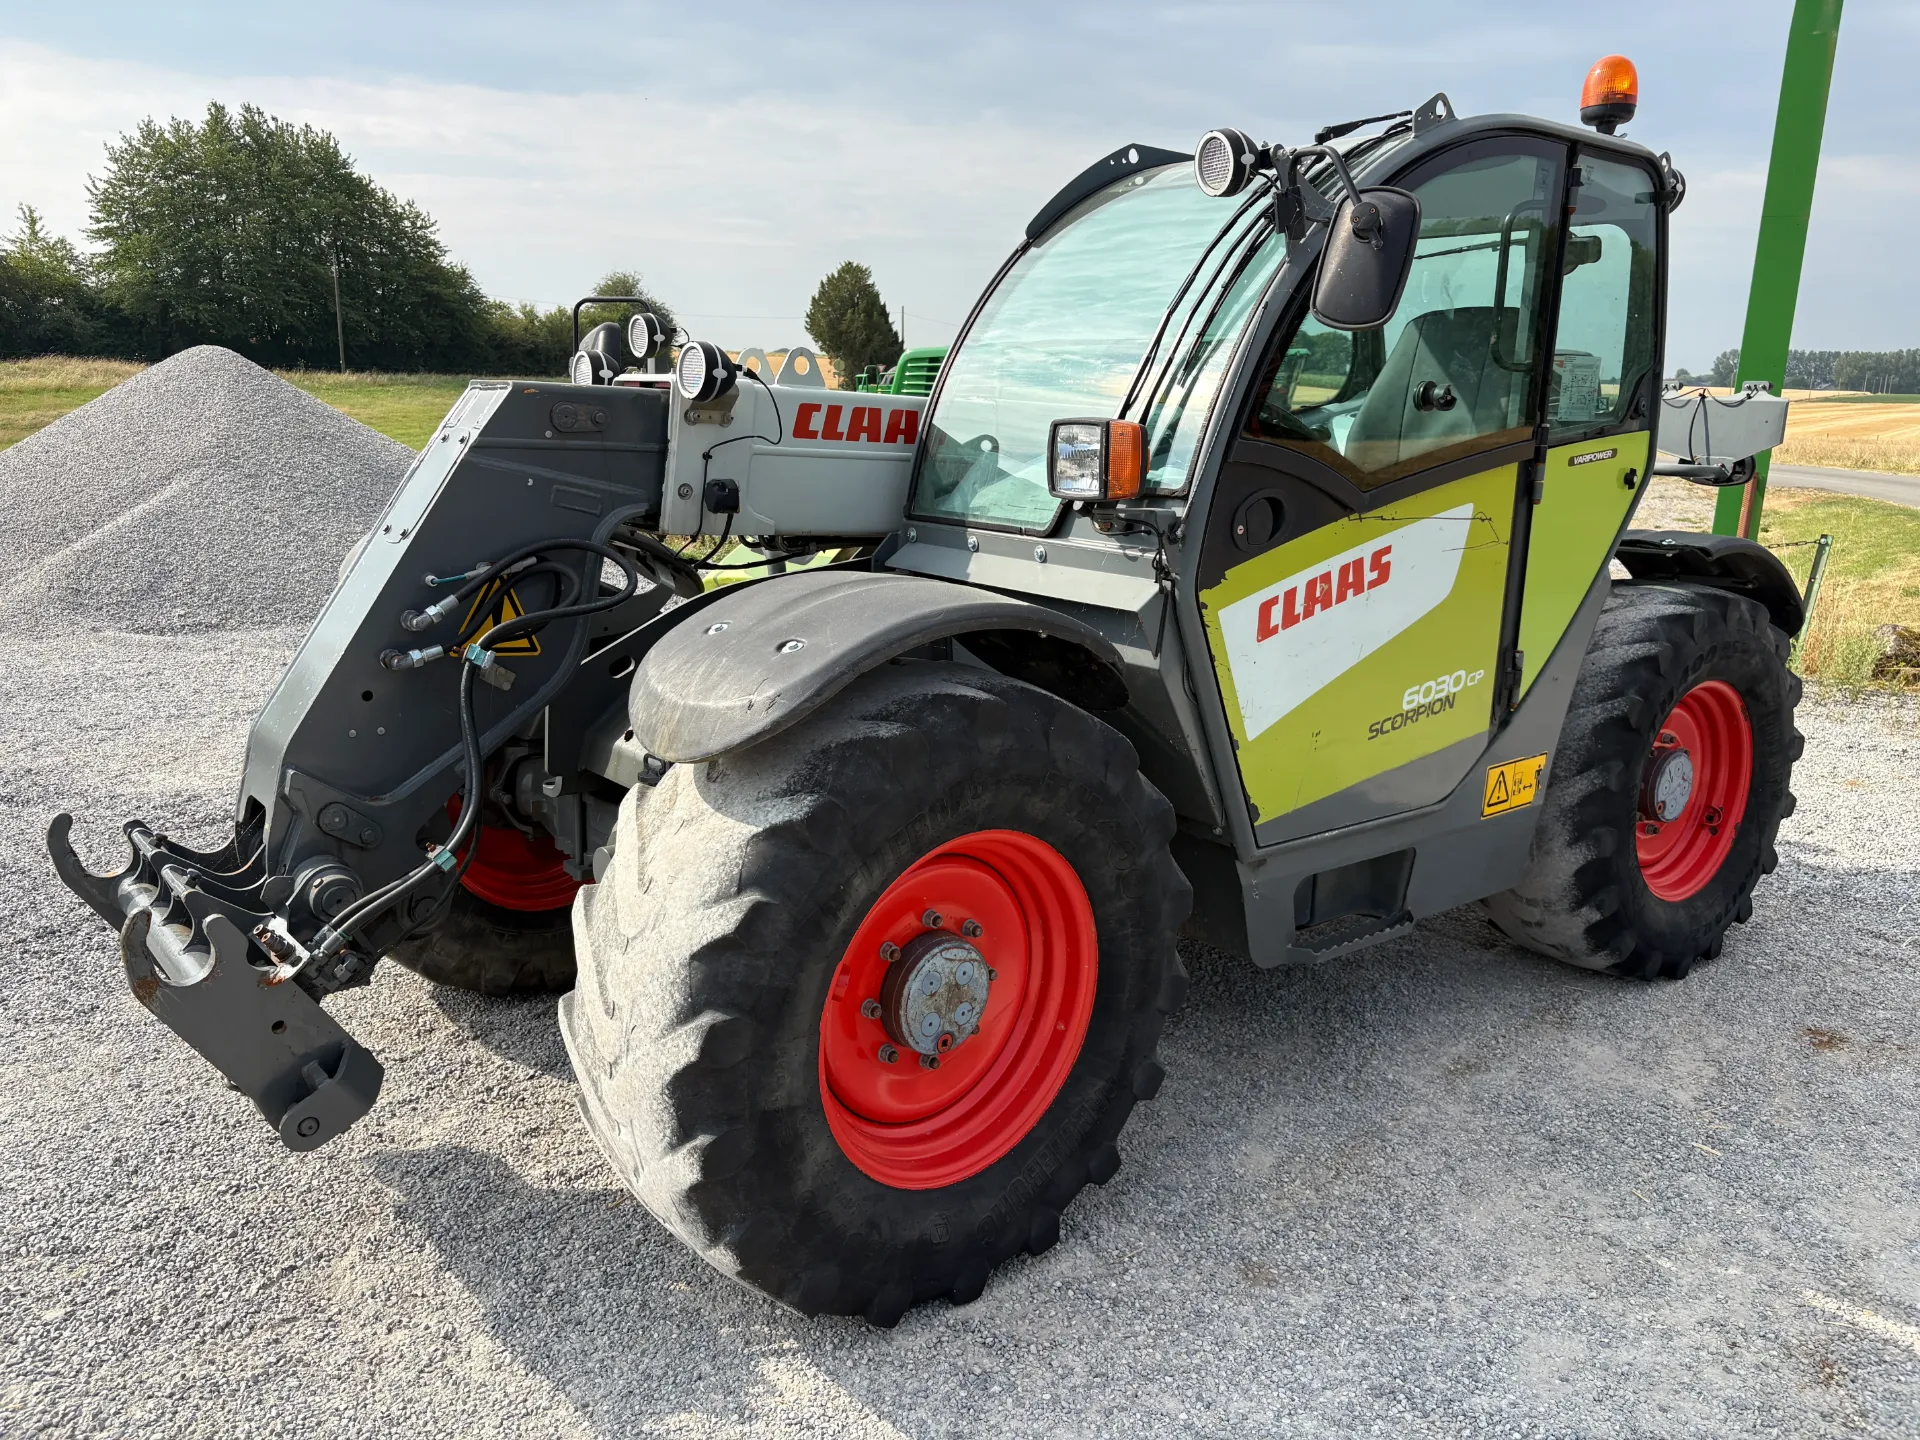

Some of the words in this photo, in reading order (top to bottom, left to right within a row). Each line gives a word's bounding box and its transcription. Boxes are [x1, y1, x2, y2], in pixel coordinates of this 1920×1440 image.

[1573, 450, 1613, 465] VARIPOWER
[1256, 544, 1393, 644] CLAAS
[1402, 669, 1466, 711] 6030
[1466, 669, 1485, 687] CP
[1367, 692, 1457, 741] SCORPION
